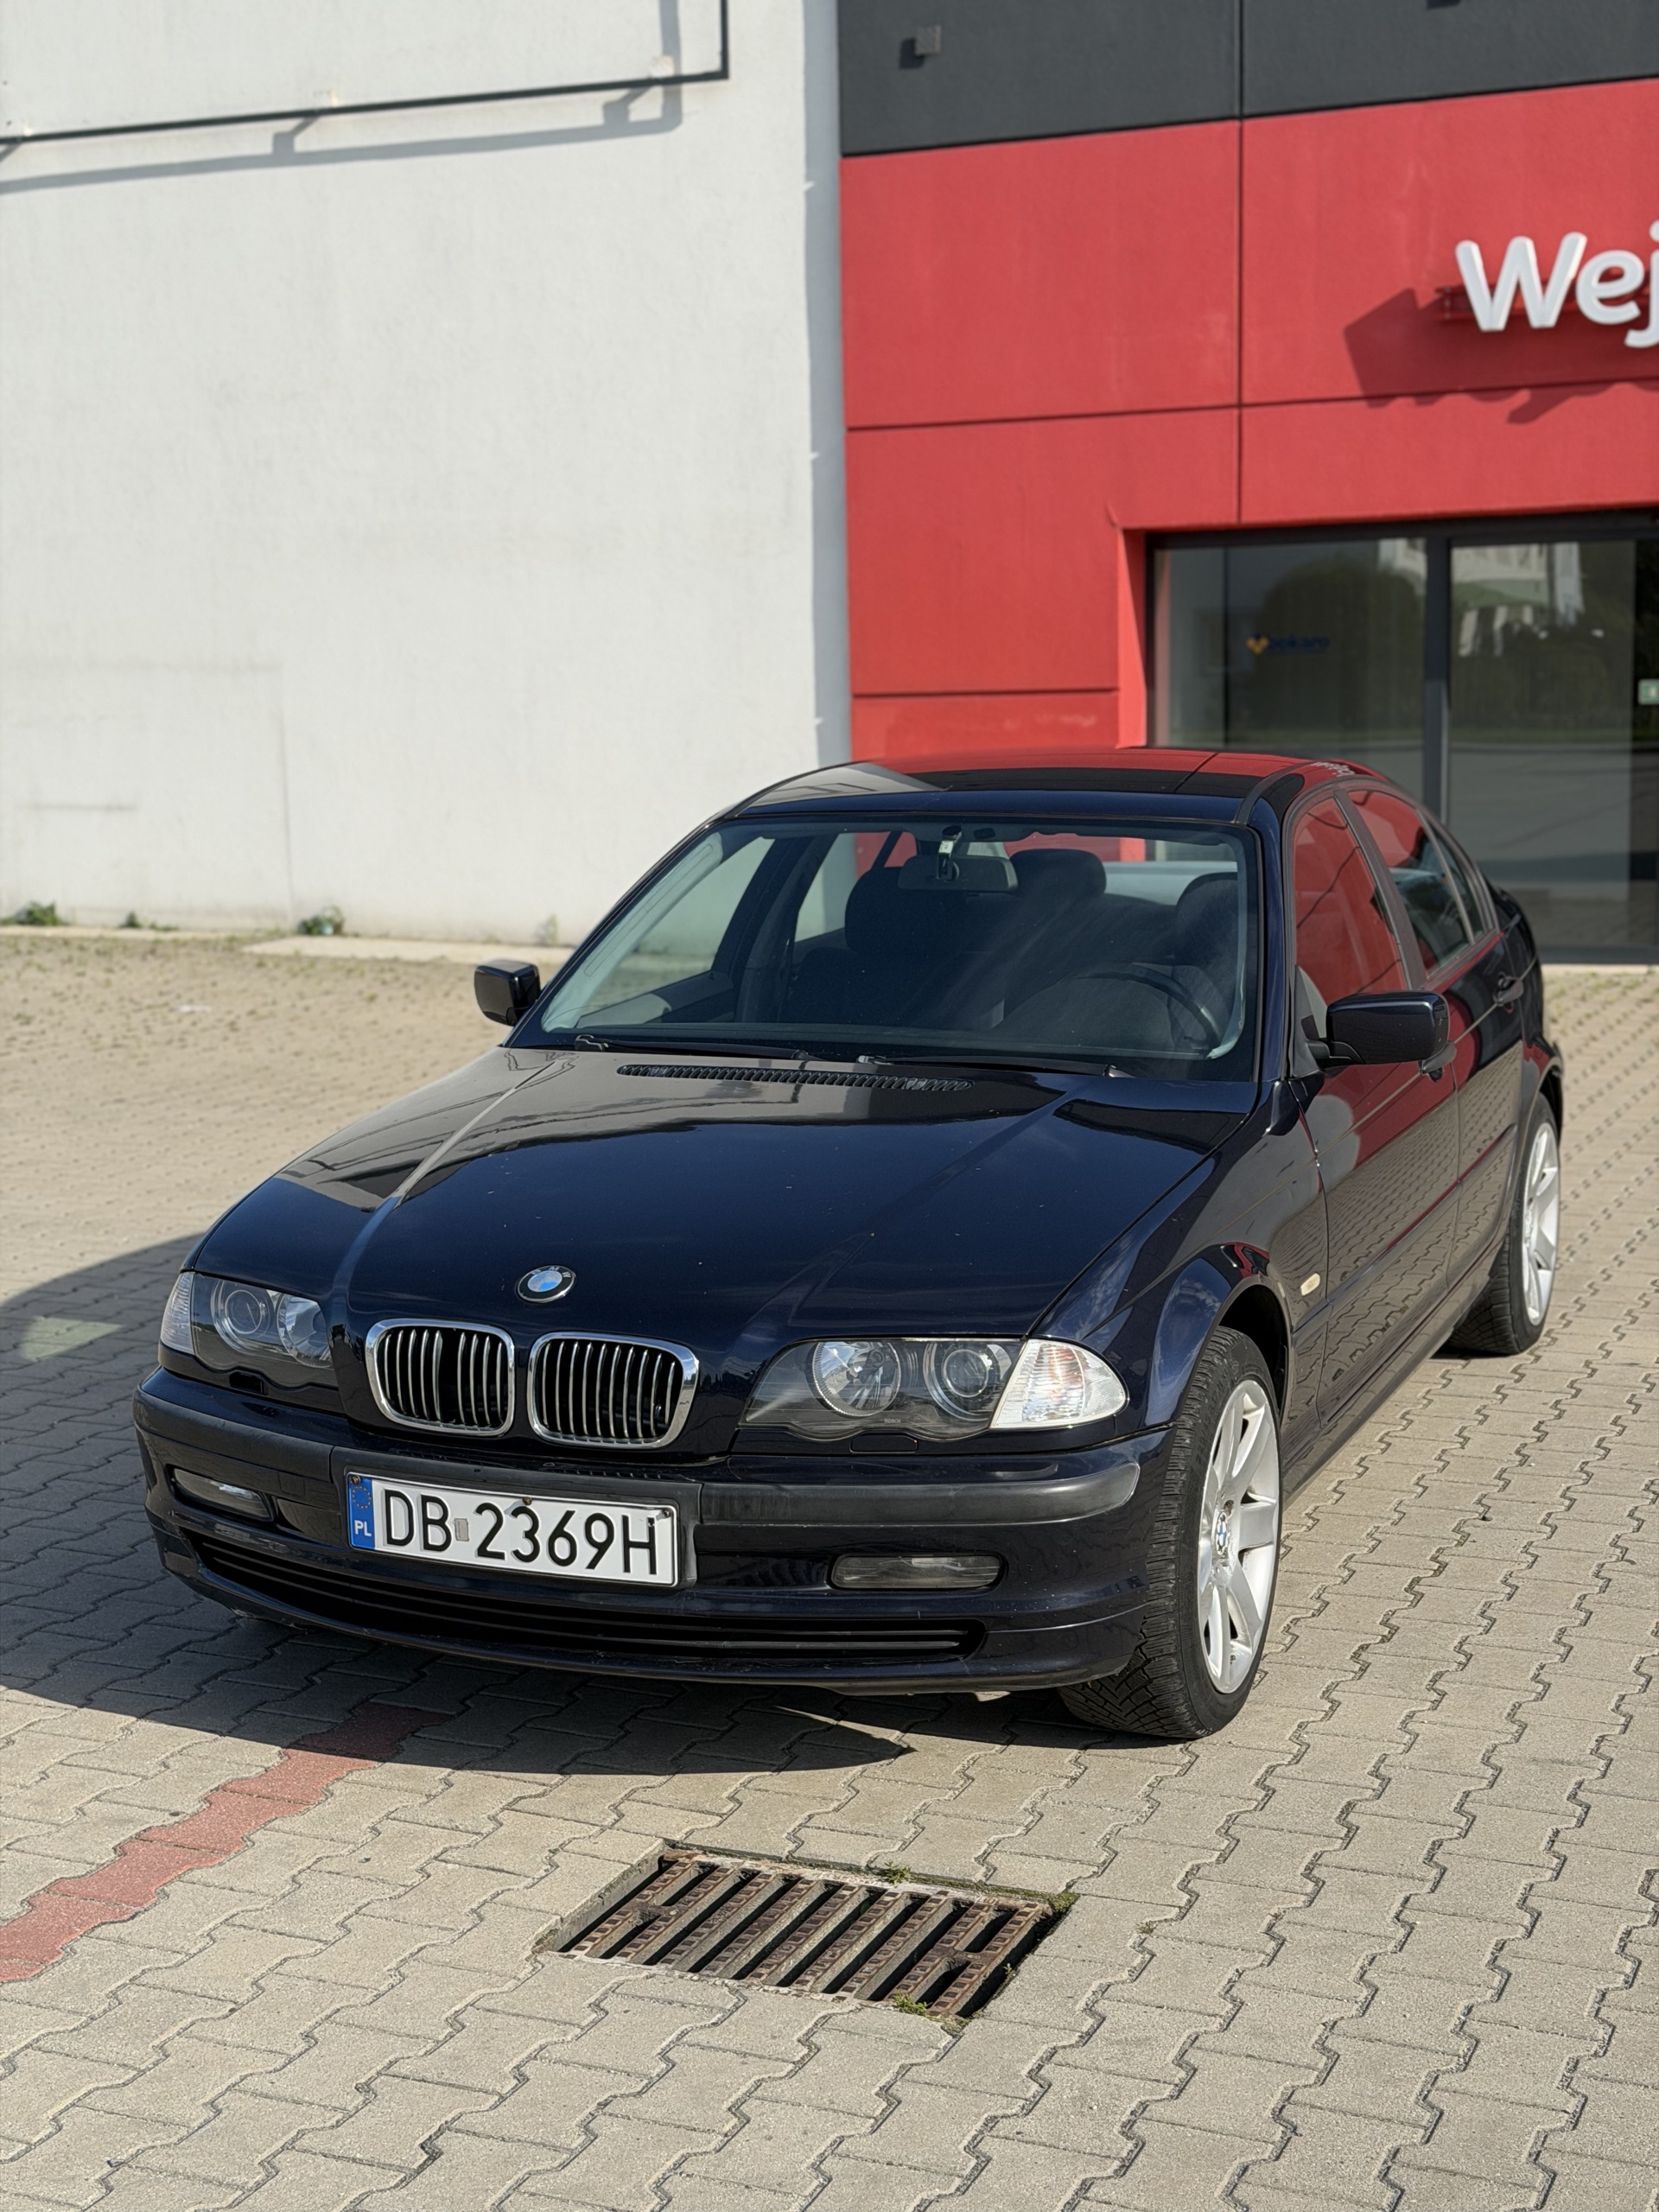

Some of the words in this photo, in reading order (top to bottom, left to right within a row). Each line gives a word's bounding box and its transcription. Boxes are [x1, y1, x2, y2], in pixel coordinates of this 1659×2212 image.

[353, 1519, 372, 1538] PL
[384, 1488, 453, 1553] DB
[474, 1501, 658, 1575] 2369H
